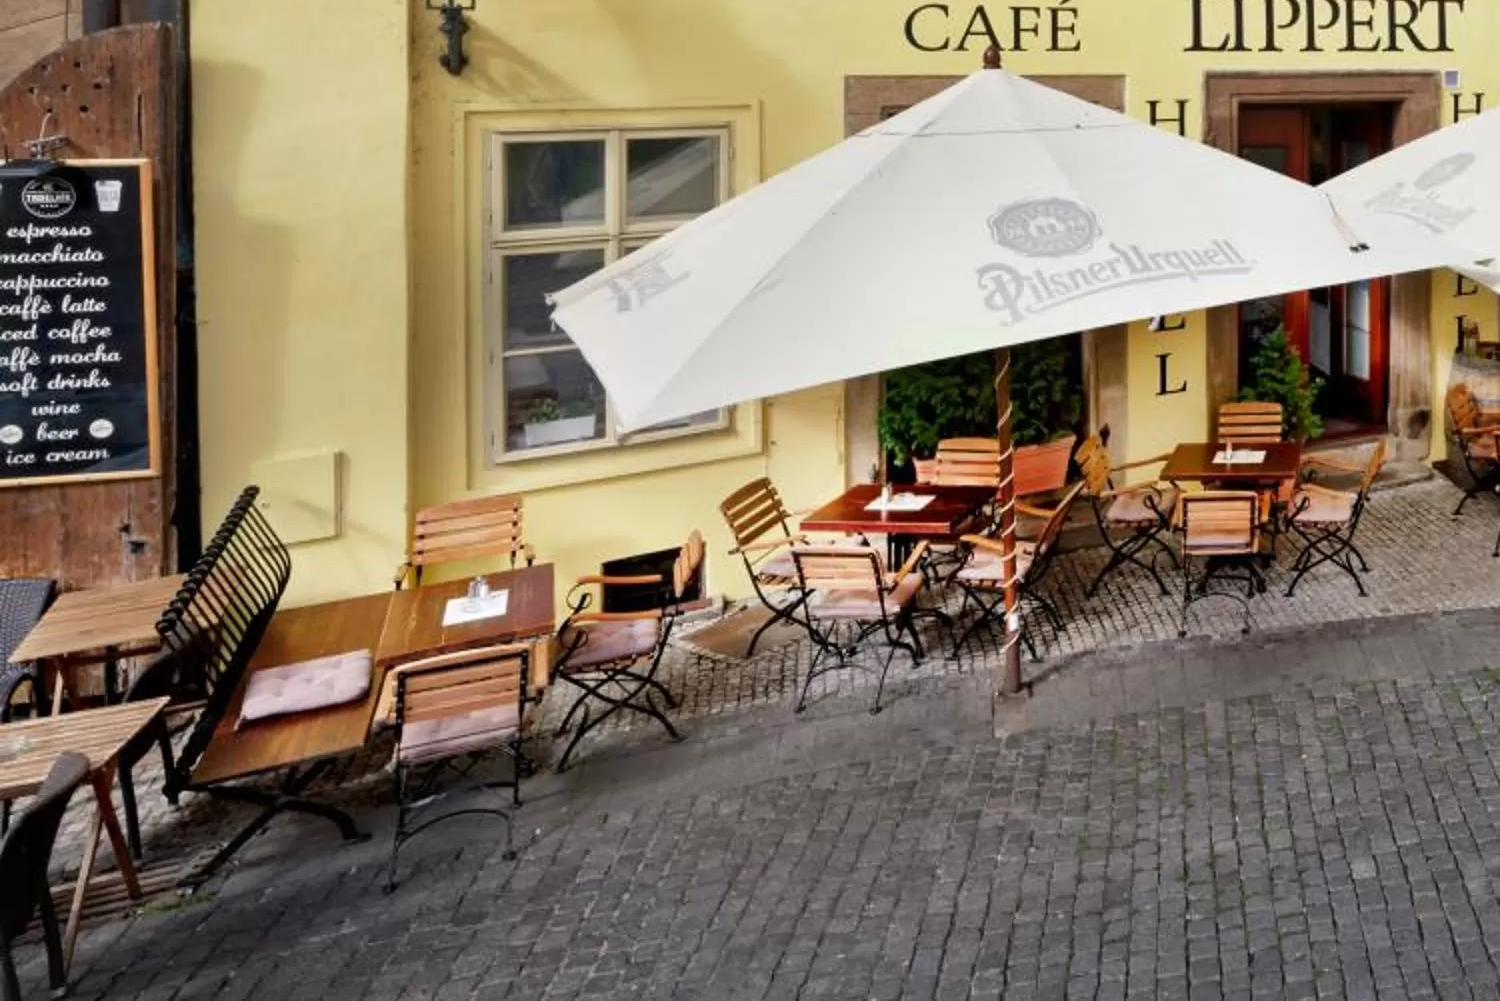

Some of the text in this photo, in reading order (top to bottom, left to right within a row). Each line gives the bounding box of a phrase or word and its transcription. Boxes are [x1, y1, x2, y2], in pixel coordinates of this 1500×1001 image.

[6, 223, 92, 244] espresso
[62, 294, 107, 314] latte
[0, 318, 112, 344] ced coffee
[0, 342, 122, 372] affè mocha
[0, 368, 110, 398] soft drinks
[31, 400, 81, 416] wine
[36, 421, 79, 441] beer
[6, 448, 110, 466] ice cream
